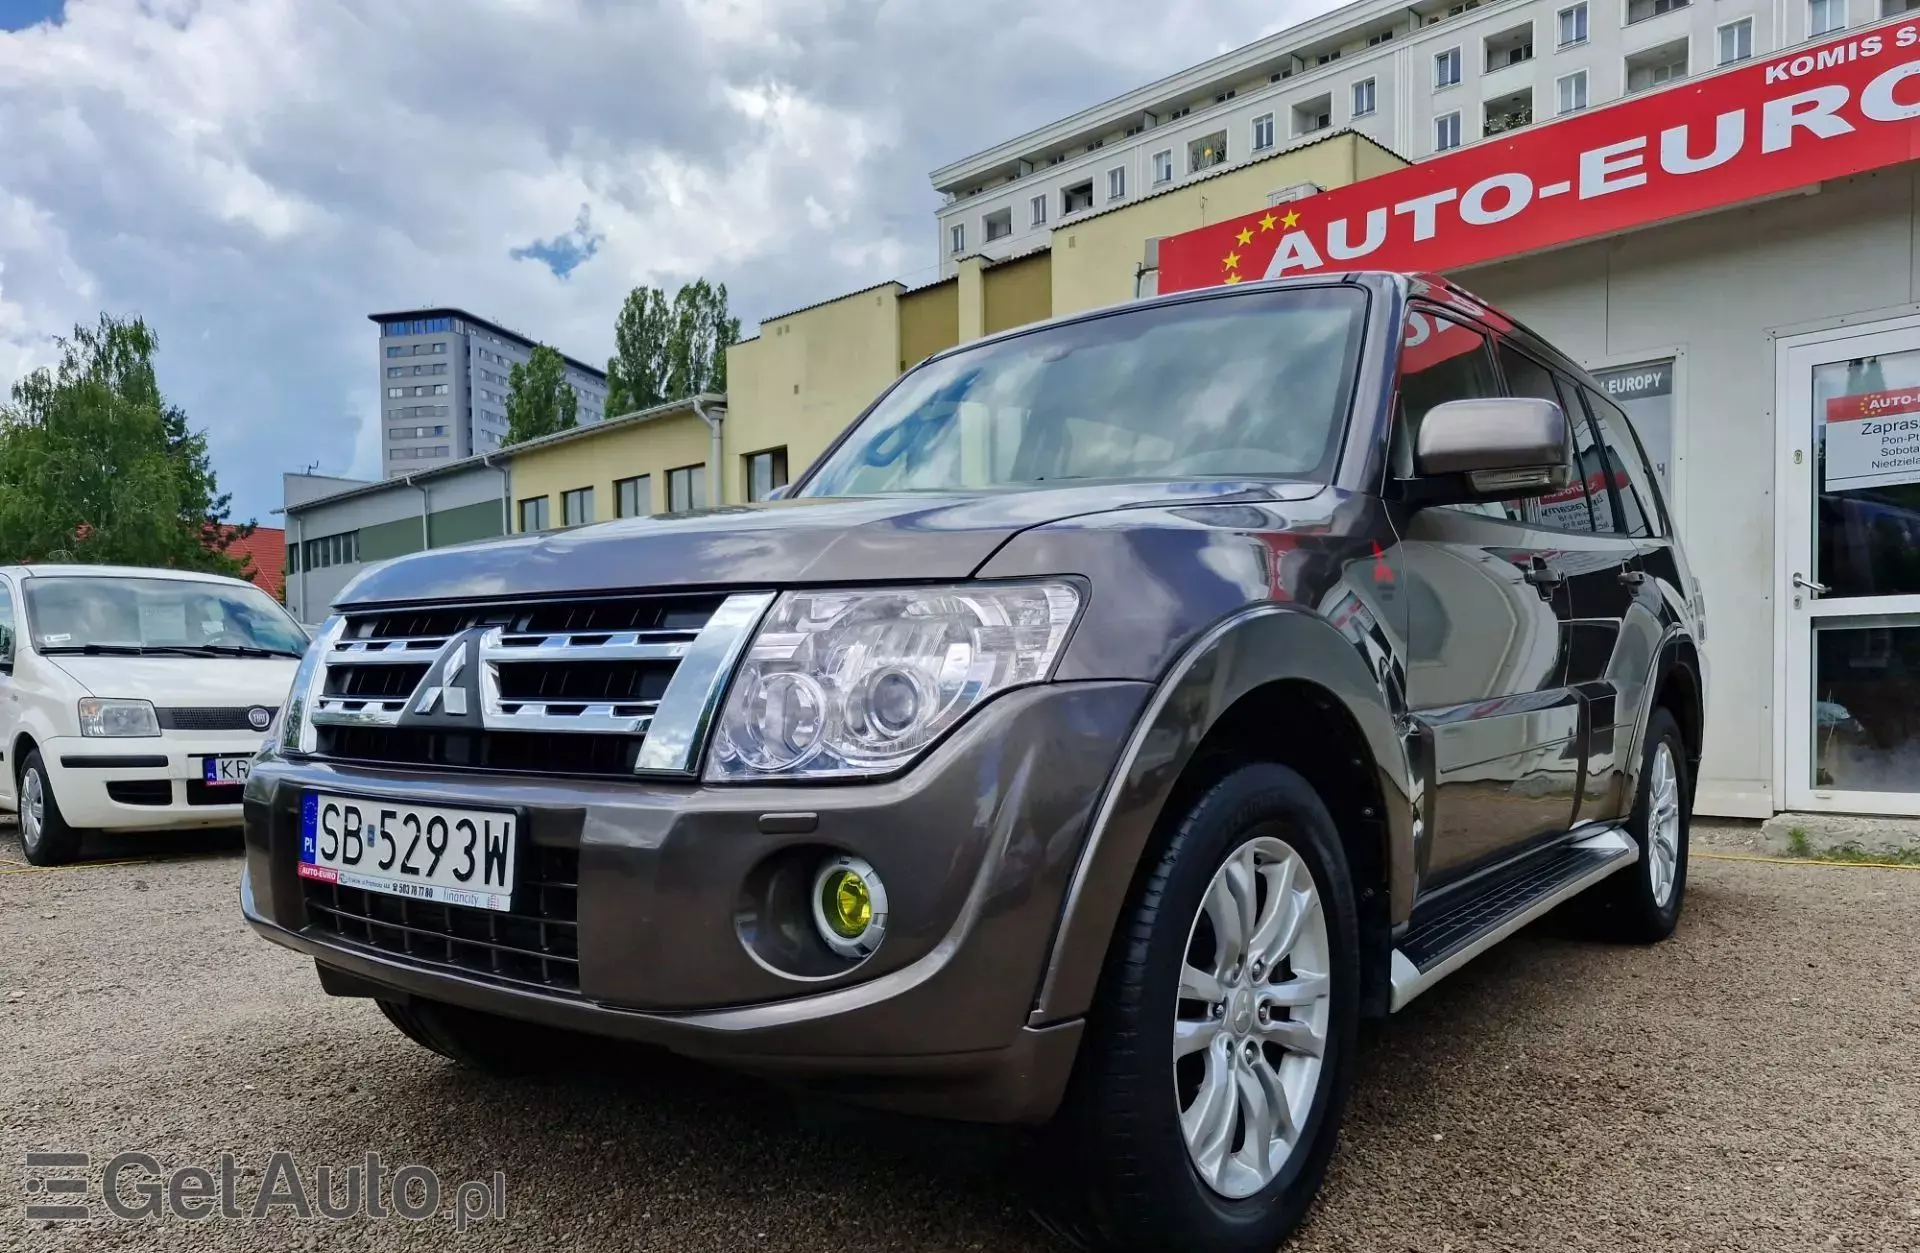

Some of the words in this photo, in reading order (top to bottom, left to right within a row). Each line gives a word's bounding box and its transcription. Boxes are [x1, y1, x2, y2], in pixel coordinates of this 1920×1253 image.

[1765, 36, 1883, 85] KOMIS
[1896, 26, 1920, 47] S
[1608, 372, 1662, 394] EUROPY
[1869, 394, 1920, 410] AUTO-
[1861, 419, 1920, 435] Zapras
[304, 837, 314, 853] PL
[320, 803, 363, 865] SB
[377, 809, 511, 887] 5293W
[301, 866, 337, 881] AUTO-EURO
